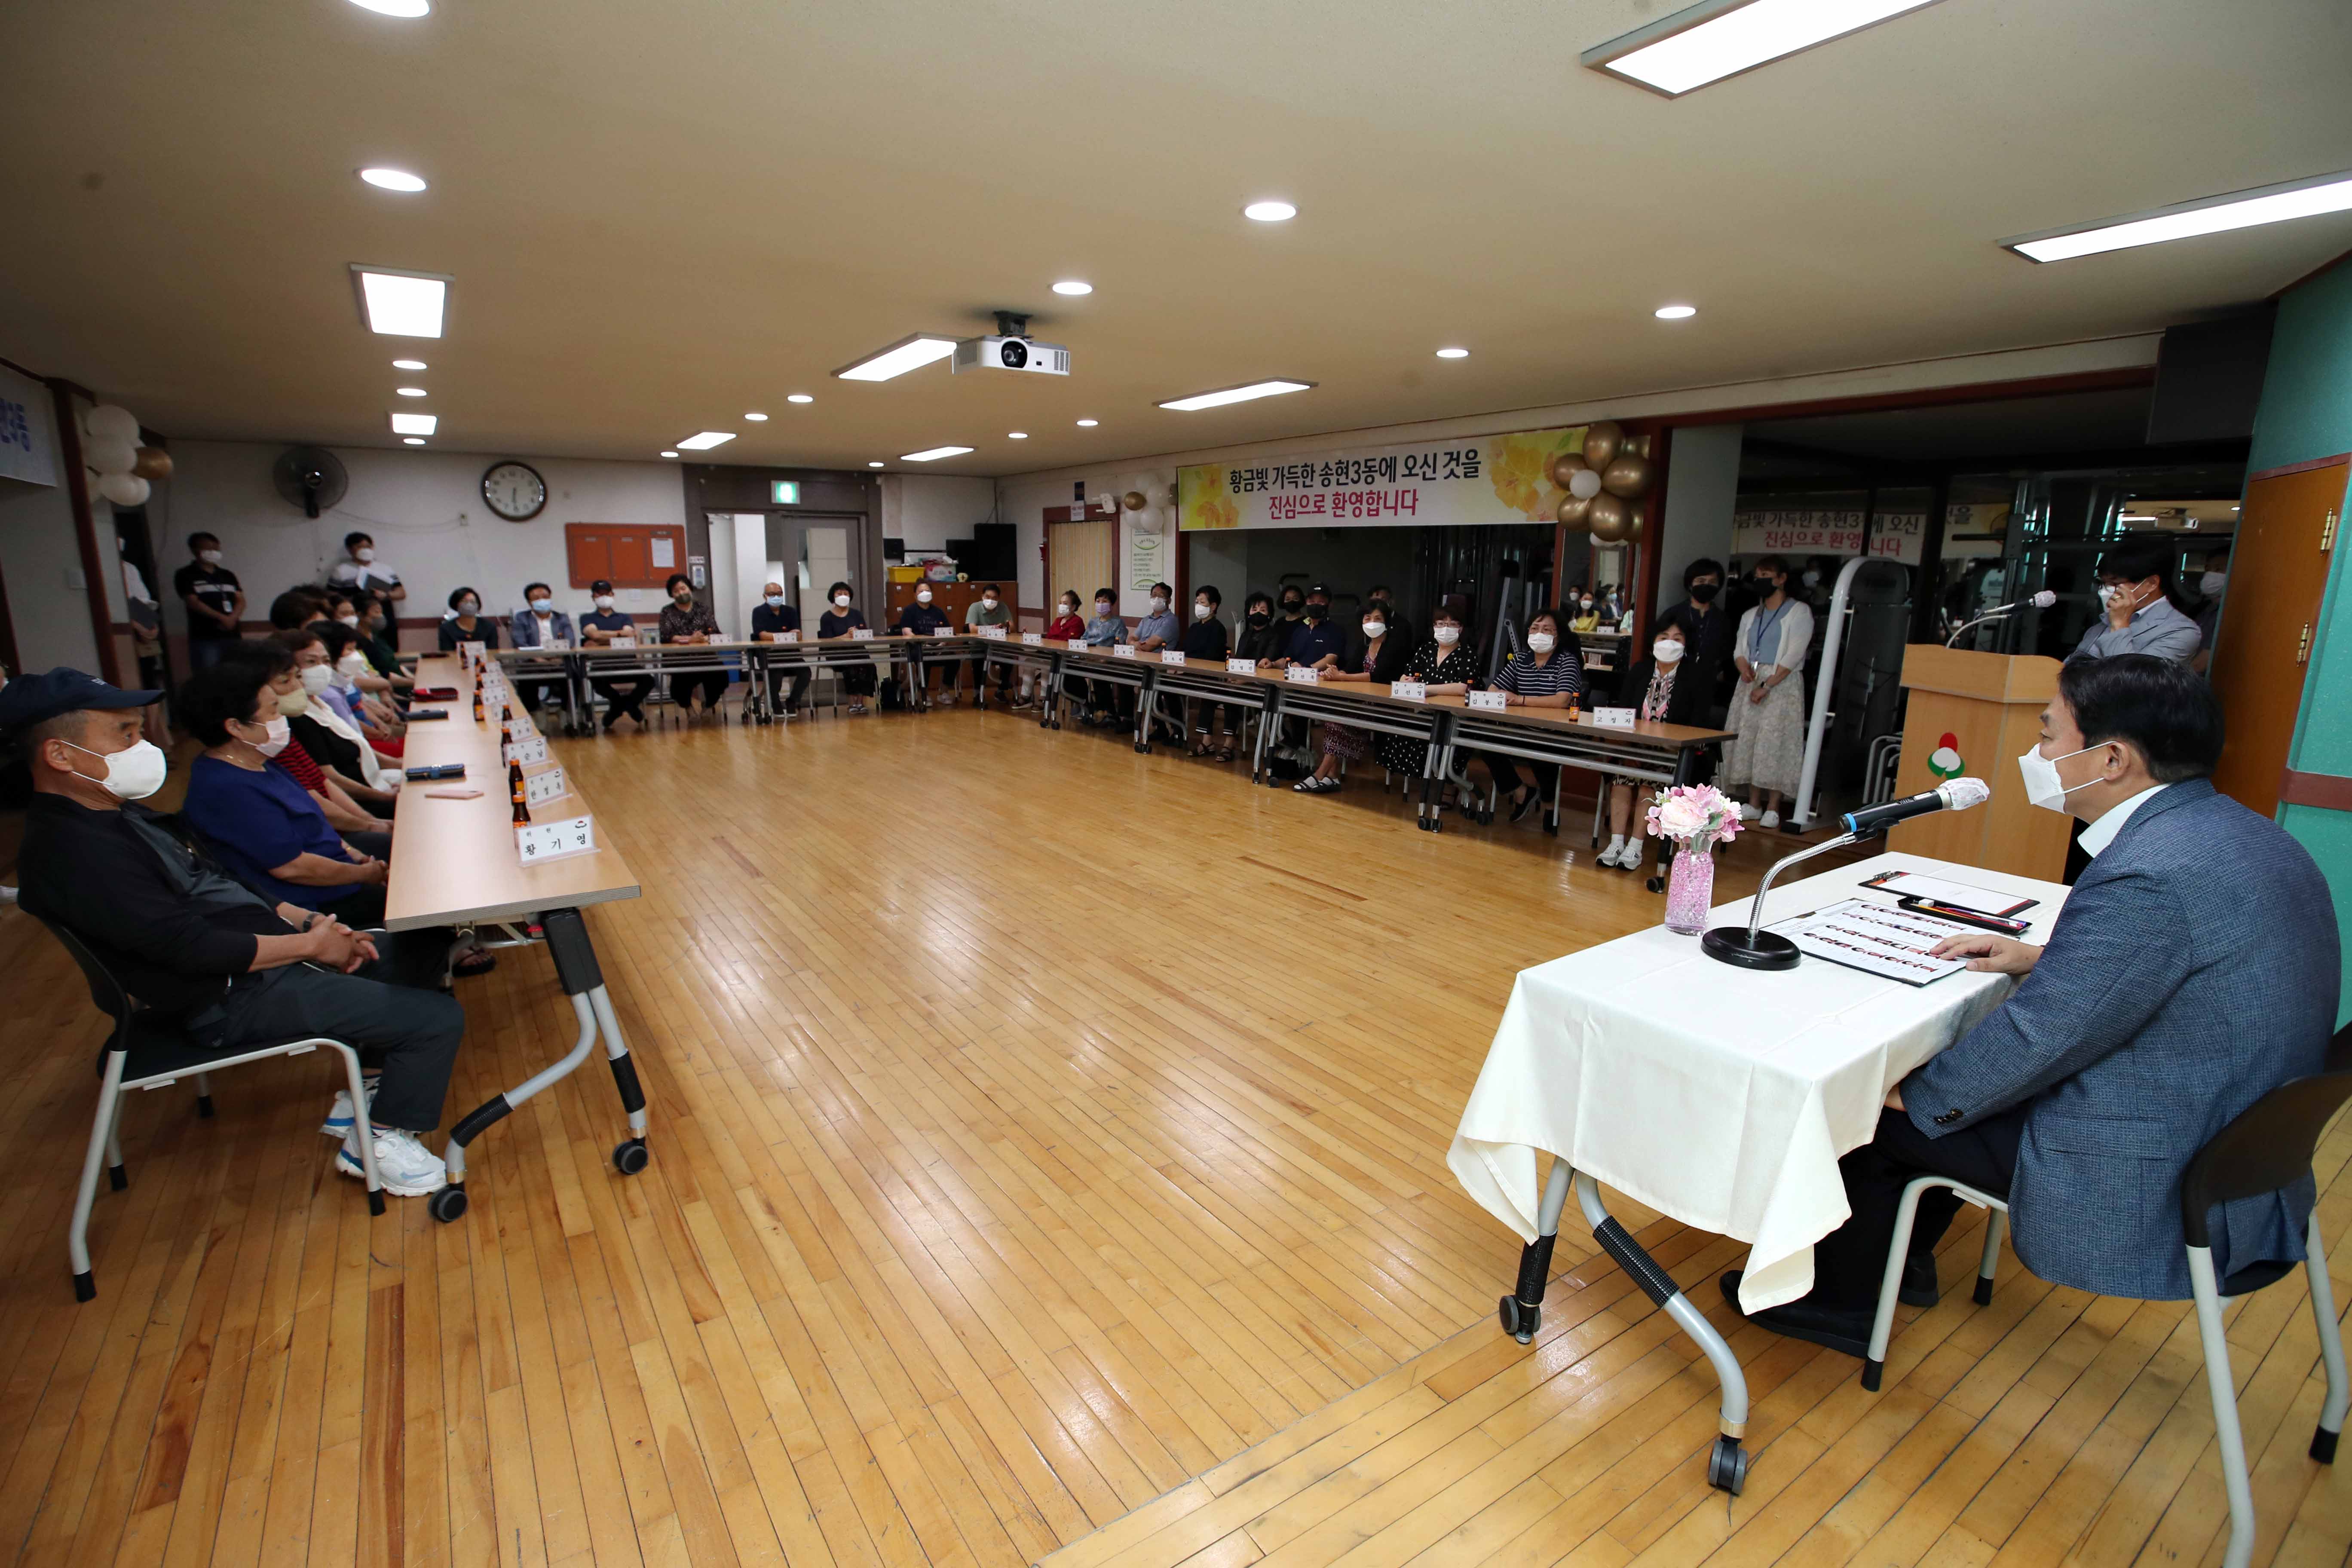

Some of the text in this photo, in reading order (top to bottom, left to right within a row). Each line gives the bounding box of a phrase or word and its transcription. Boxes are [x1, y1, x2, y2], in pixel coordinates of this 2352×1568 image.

[1229, 448, 1482, 493] 황금빛 가득한 송현3동에 오신 것을
[1269, 488, 1418, 520] 진심으로 환영합니다
[1733, 512, 1765, 529] 금빛
[1887, 515, 1920, 535] 오신
[1765, 531, 1902, 557] 진심으로 환영니다
